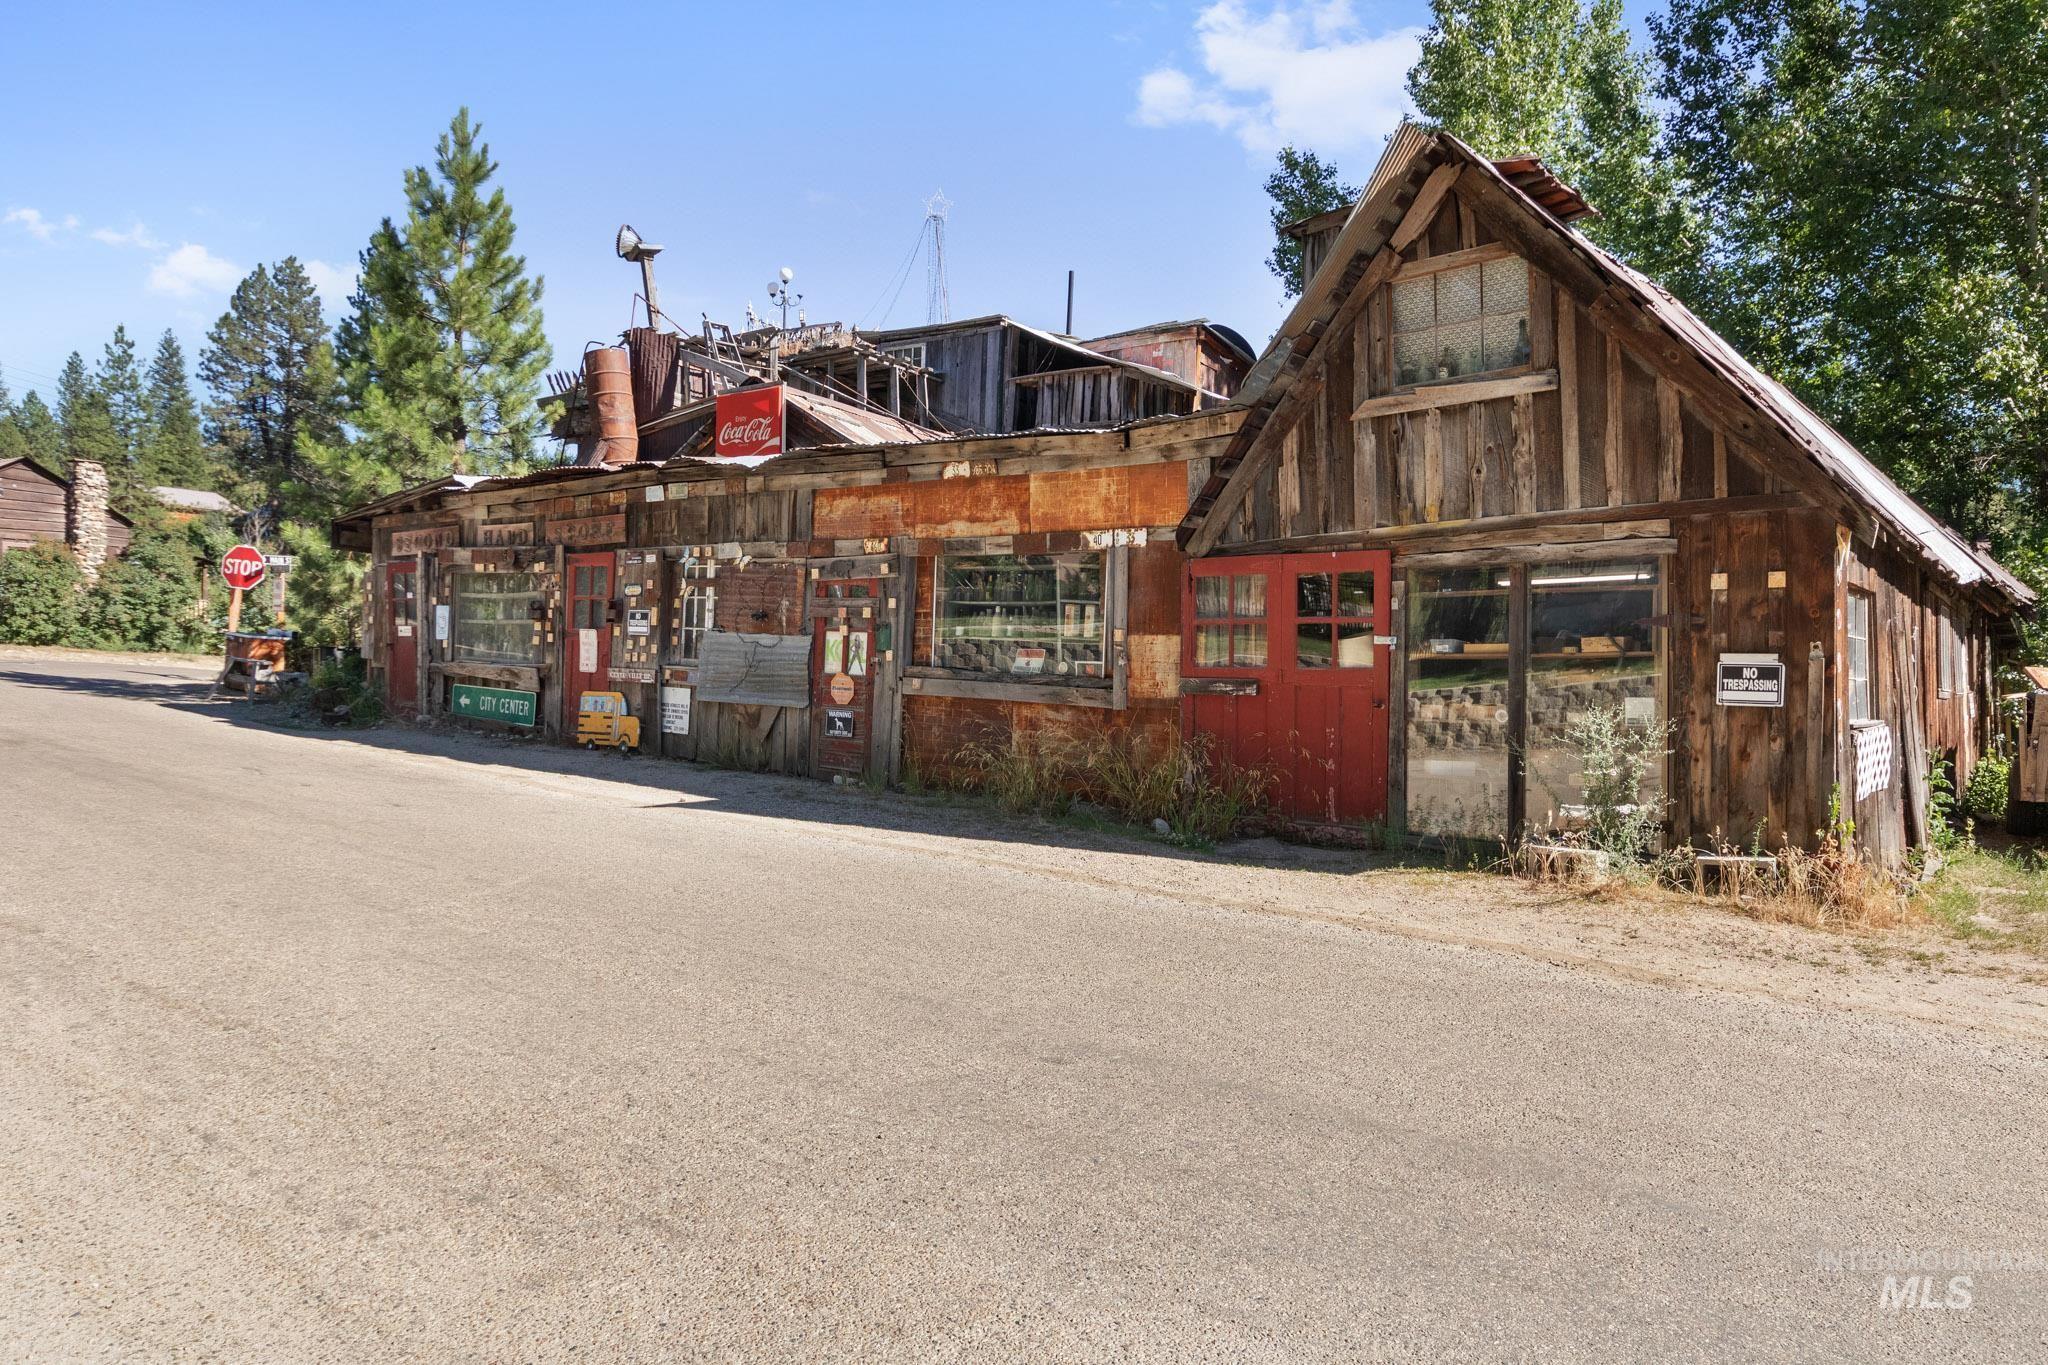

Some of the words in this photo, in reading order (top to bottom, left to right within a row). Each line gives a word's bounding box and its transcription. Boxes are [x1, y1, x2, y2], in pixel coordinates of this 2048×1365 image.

[719, 415, 774, 446] Coca-Cola
[483, 528, 529, 546] HAND
[224, 558, 263, 576] STOP
[1742, 667, 1758, 679] NO
[1723, 679, 1778, 691] TRESPASSING
[480, 696, 496, 711] CITY
[500, 698, 529, 716] CENTER
[828, 711, 852, 719] WARNING
